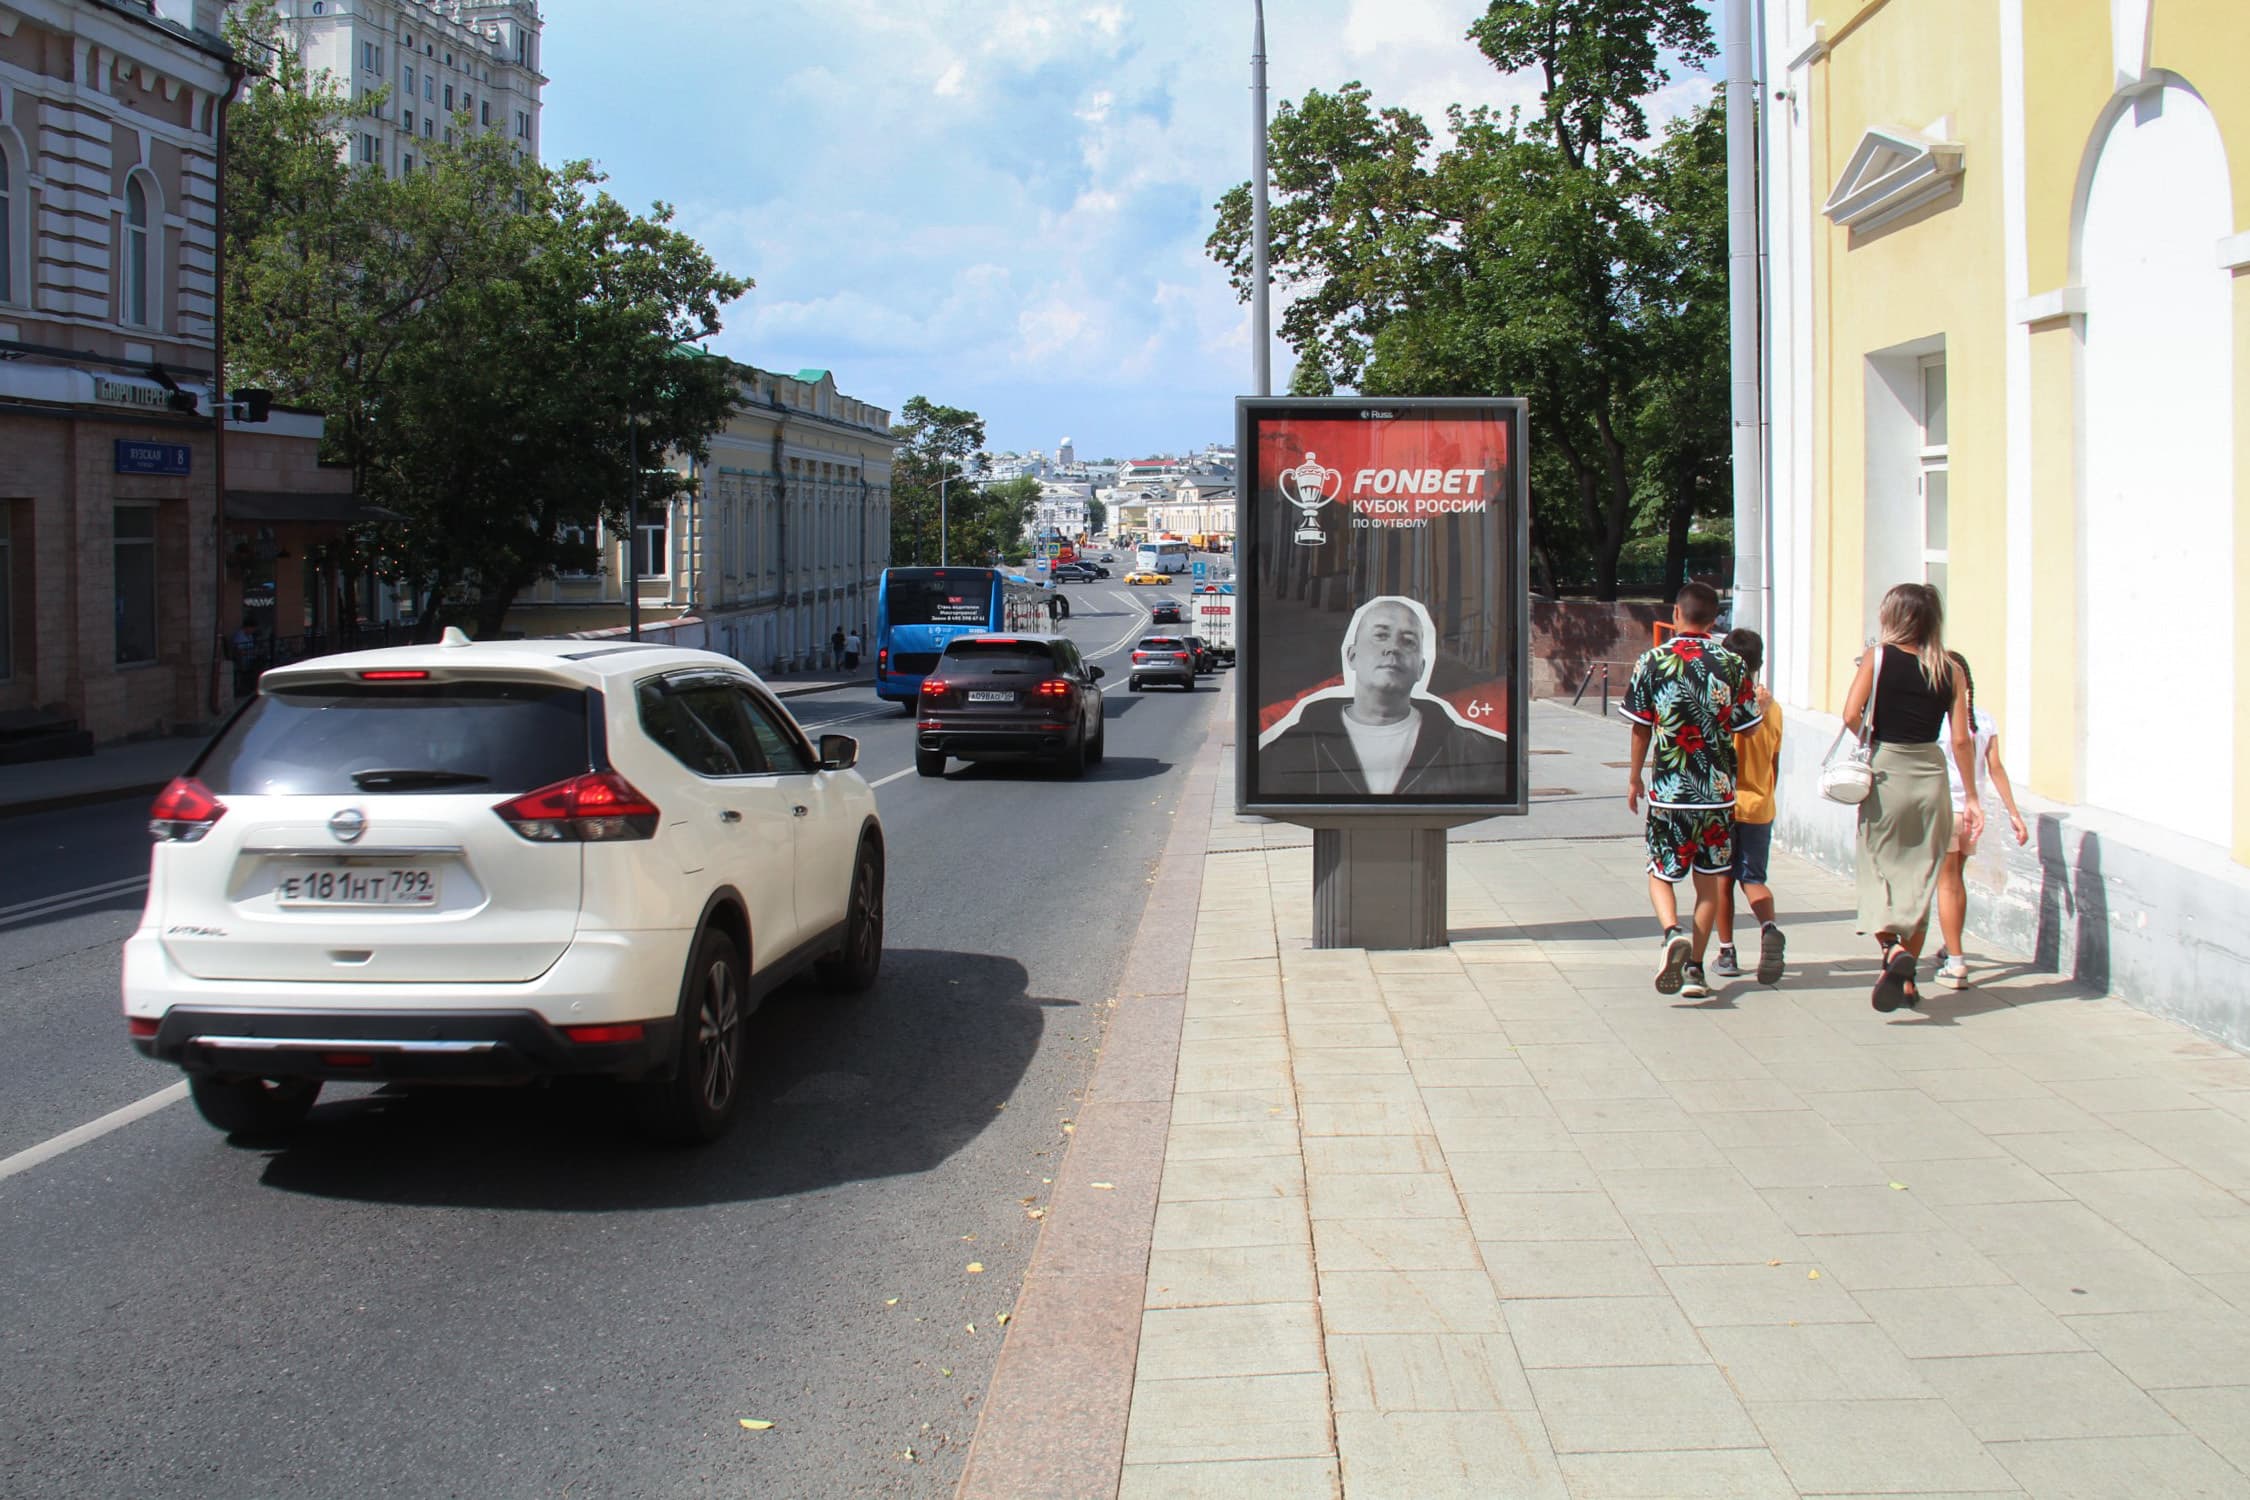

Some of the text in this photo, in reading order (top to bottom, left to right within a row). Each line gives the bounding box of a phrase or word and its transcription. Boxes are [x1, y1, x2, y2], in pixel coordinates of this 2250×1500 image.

[102, 382, 133, 401] БЮРО
[1371, 410, 1394, 419] Russ
[177, 449, 184, 465] 8
[1353, 468, 1486, 495] FONBET
[1353, 500, 1487, 514] КУБОК РОССИИ
[1353, 518, 1429, 529] ПО ФУТБОЛУ
[1467, 699, 1494, 718] 6+
[389, 871, 431, 892] 799
